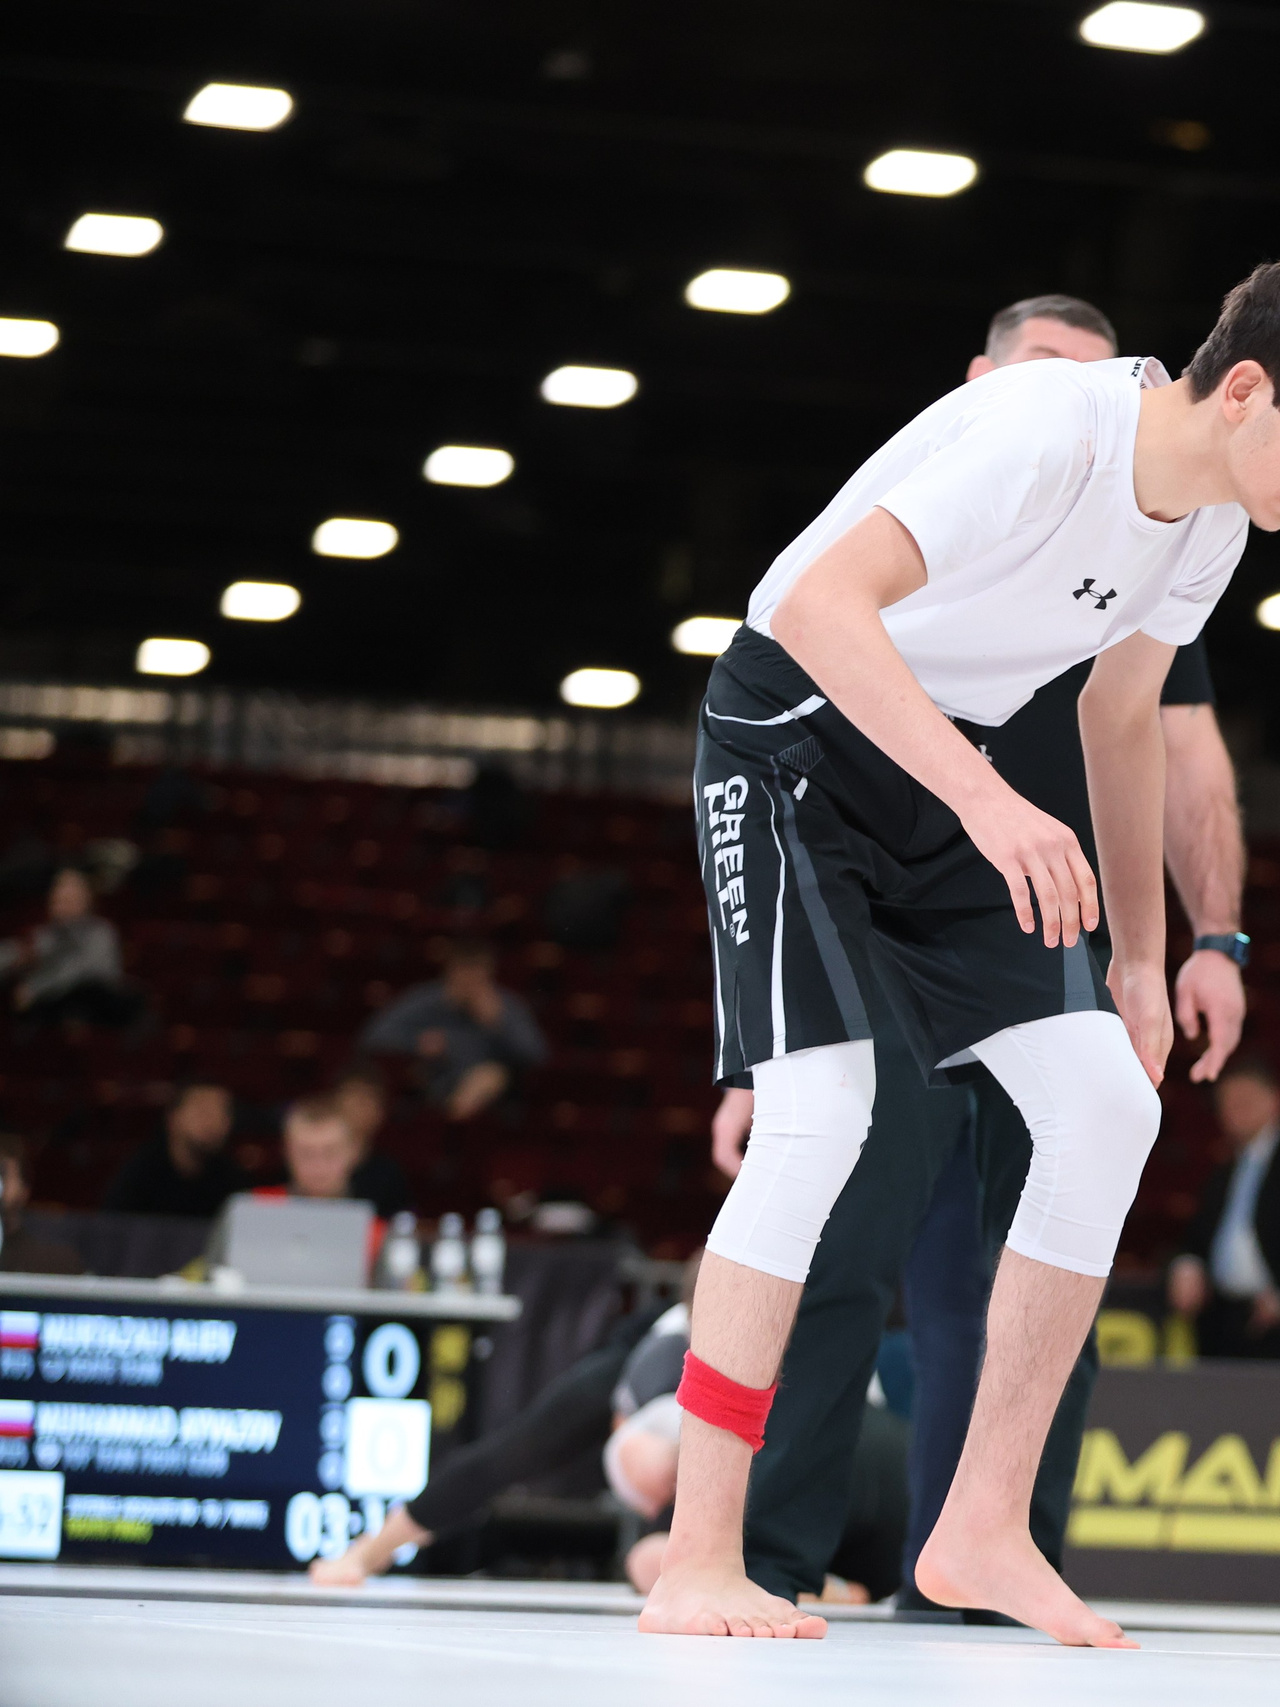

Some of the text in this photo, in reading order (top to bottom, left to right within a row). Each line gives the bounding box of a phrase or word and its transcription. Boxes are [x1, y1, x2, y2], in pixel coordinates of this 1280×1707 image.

[703, 781, 728, 932] HILL
[720, 774, 750, 947] GREEN
[363, 1323, 421, 1399] 0
